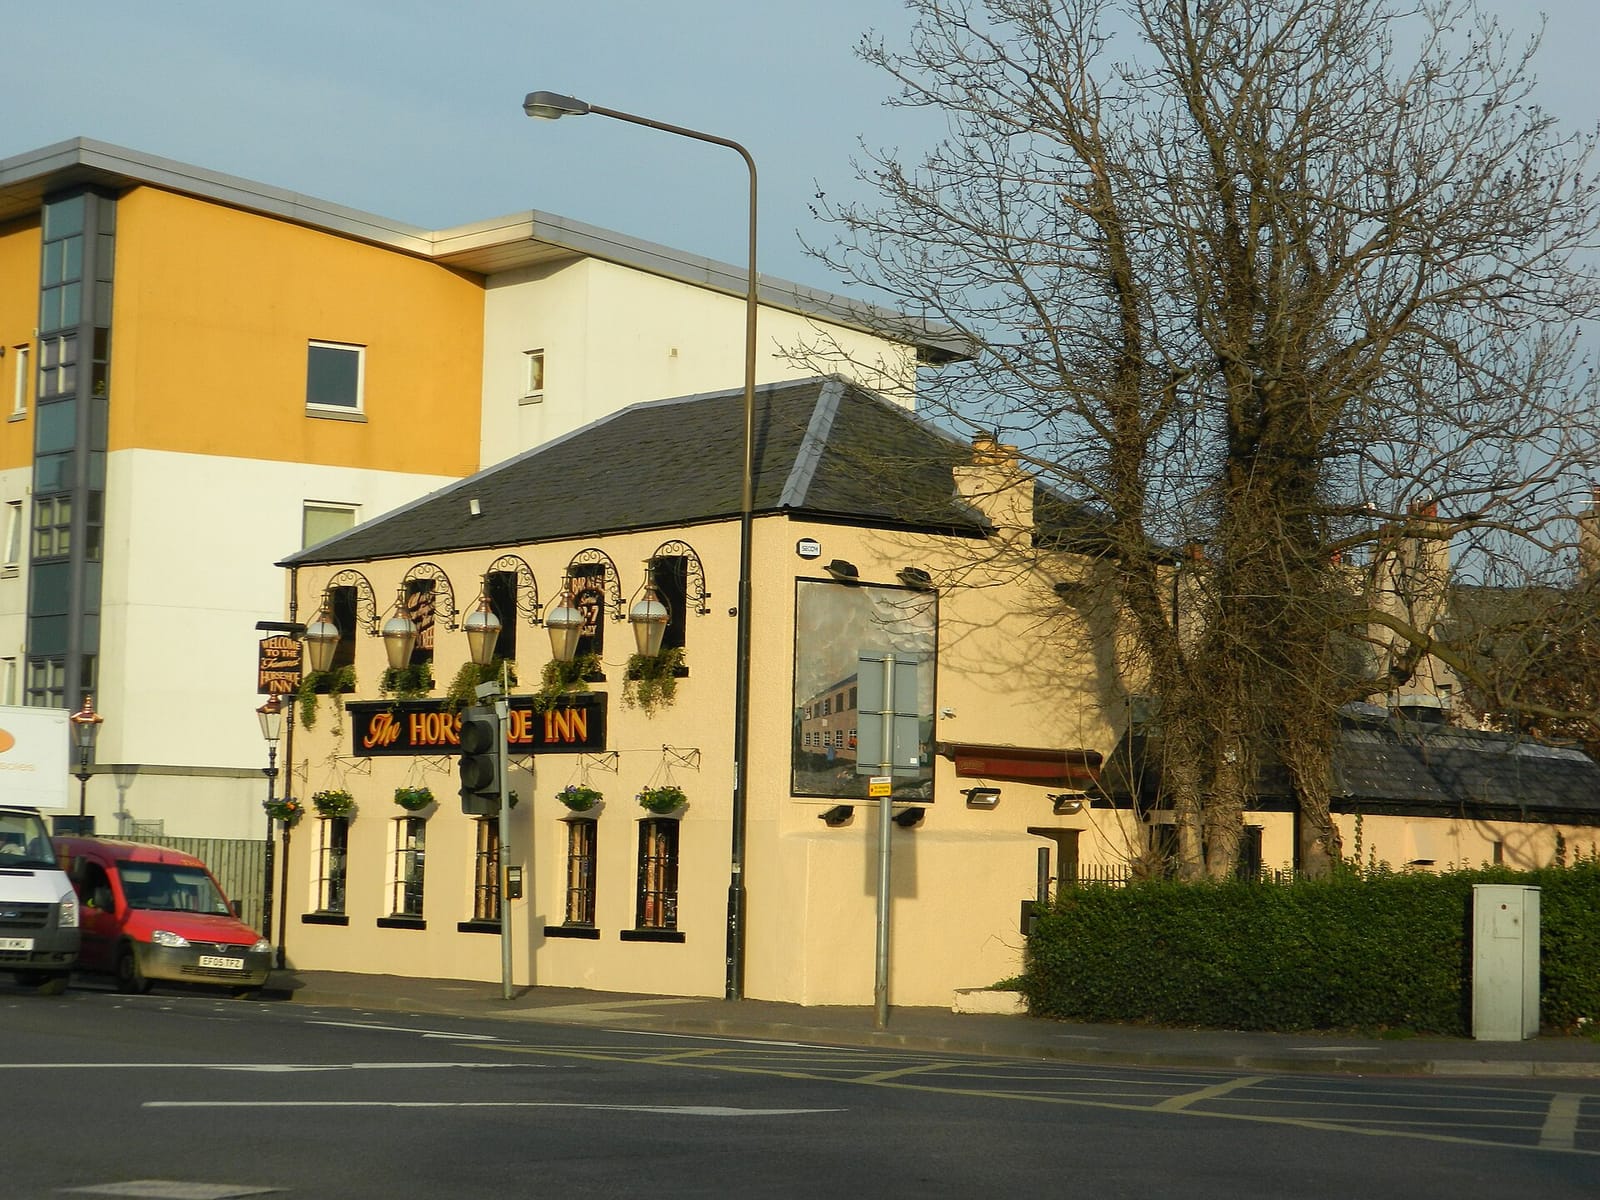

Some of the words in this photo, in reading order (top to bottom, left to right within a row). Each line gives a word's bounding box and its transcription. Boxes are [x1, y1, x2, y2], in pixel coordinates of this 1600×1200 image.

[262, 637, 301, 650] WELCOME
[265, 649, 280, 657] TO
[281, 649, 297, 657] THE
[269, 680, 292, 692] INN
[363, 713, 401, 748] The
[544, 708, 588, 744] INN
